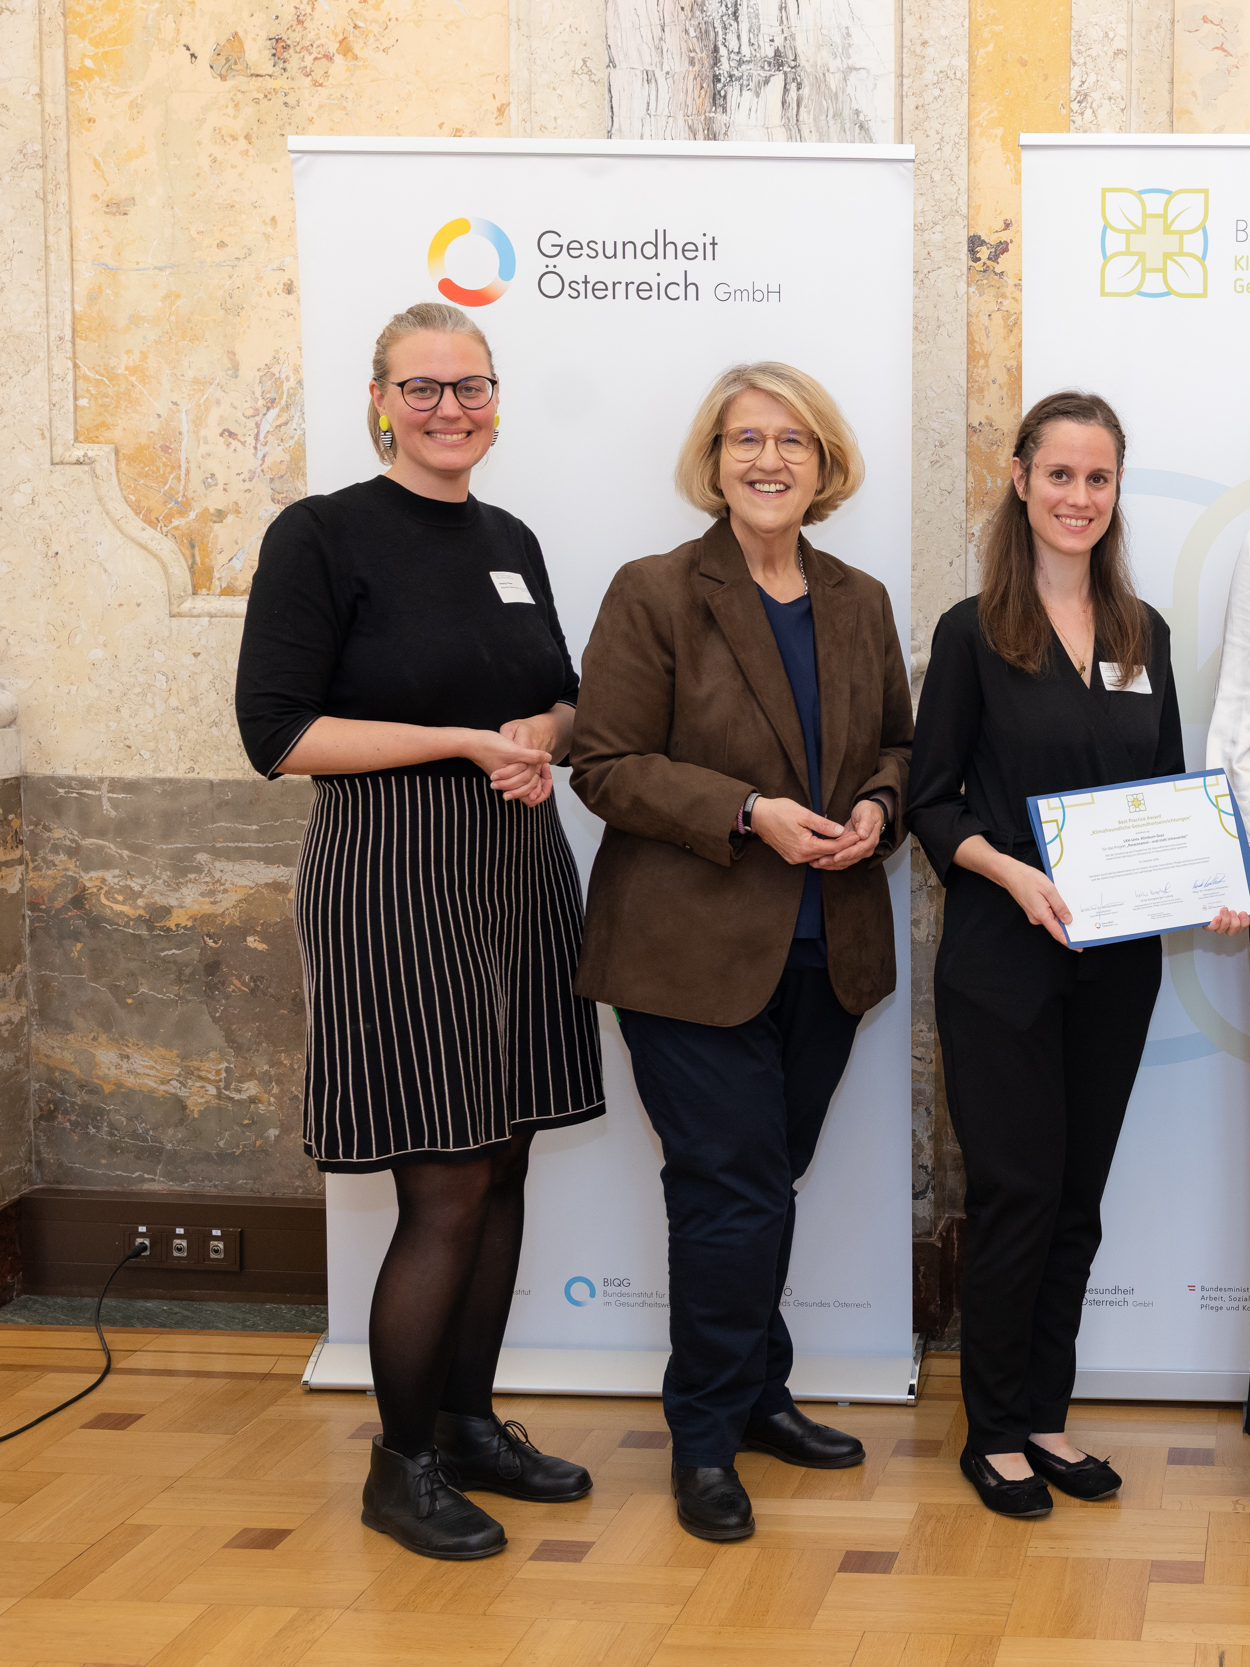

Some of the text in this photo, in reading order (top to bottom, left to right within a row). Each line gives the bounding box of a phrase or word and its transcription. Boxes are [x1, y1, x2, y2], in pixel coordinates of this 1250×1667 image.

[536, 228, 719, 262] Gesundheit
[537, 264, 782, 304] Österreich GmbH
[602, 1277, 632, 1288] BIQG
[602, 1289, 666, 1299] Bundesinstitut für
[1085, 1284, 1135, 1297] esundheit
[793, 1299, 831, 1308] Gesundes
[832, 1299, 872, 1309] Österreich
[1132, 1299, 1155, 1309] GmbH
[1200, 1294, 1227, 1304] Arbeit,
[603, 1299, 671, 1310] im Gesundheitswe
[1200, 1303, 1224, 1313] Pflege
[1226, 1304, 1240, 1312] und
